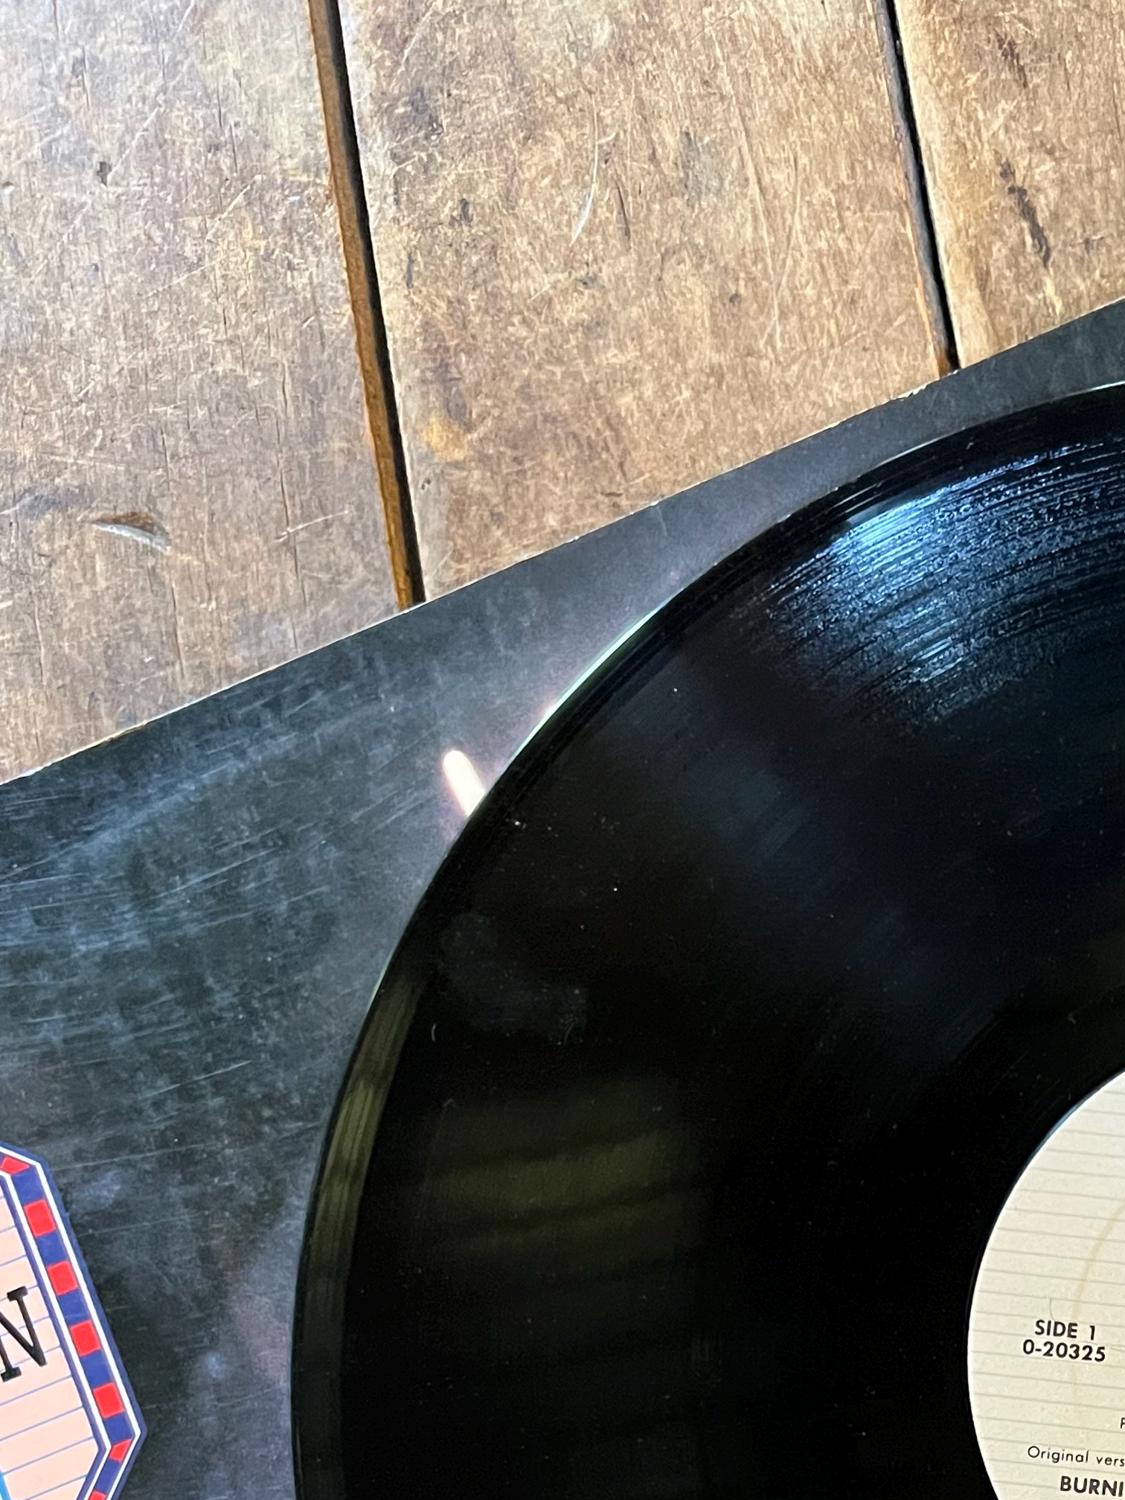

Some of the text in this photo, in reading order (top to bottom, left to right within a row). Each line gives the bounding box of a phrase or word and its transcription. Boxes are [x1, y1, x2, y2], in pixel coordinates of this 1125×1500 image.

[1034, 1319, 1096, 1341] SIDE 1
[1022, 1338, 1106, 1363] 0-20325
[1026, 1445, 1089, 1465] Original
